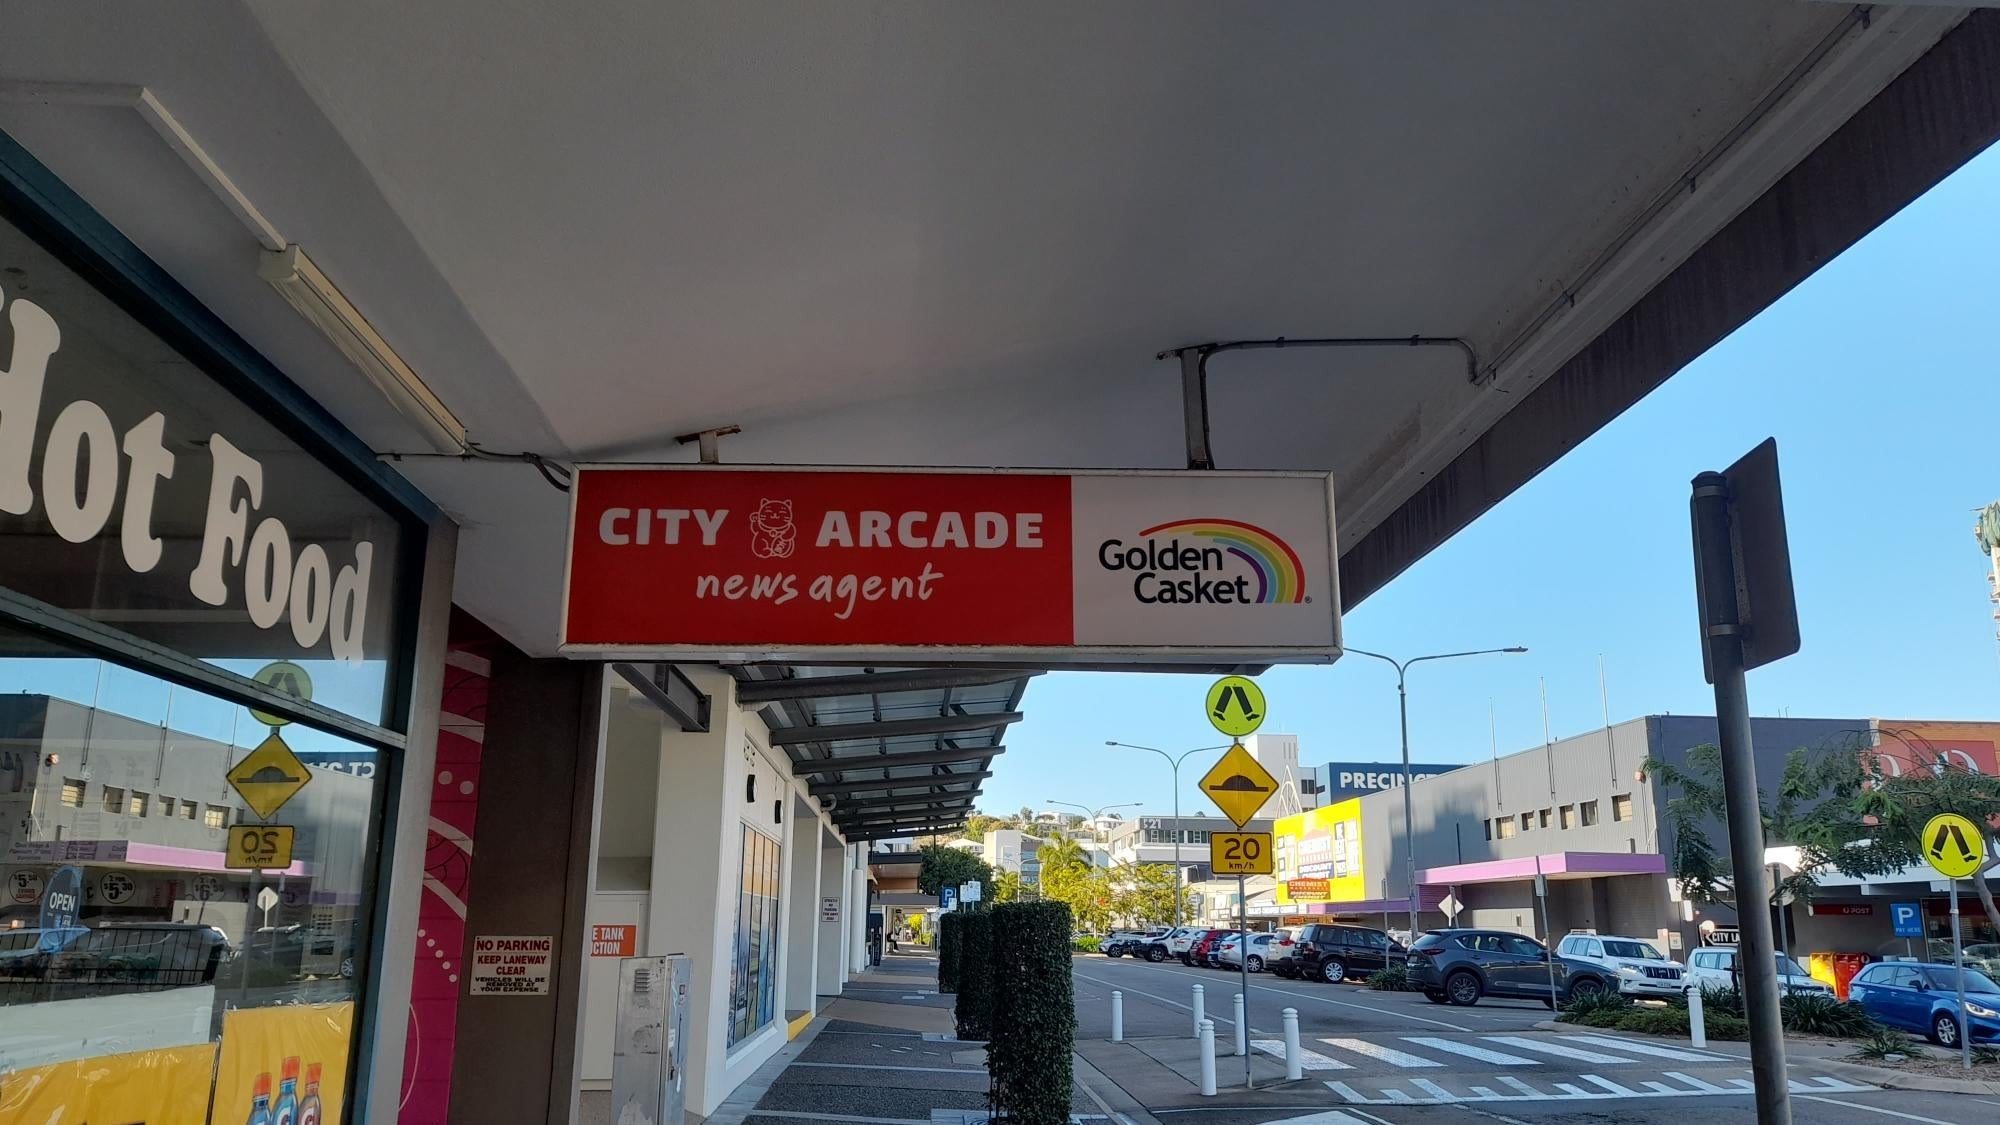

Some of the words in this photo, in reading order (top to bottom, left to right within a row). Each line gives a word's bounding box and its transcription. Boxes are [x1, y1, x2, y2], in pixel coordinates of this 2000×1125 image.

[0, 282, 175, 573] Hot
[189, 432, 373, 668] Food
[598, 508, 730, 545] CITY
[815, 511, 1043, 549] ARCADE
[1098, 539, 1223, 571] Golden
[696, 572, 799, 604] news
[808, 562, 944, 620] agent
[1133, 572, 1251, 604] Casket
[1340, 771, 1441, 789] PRECINC
[1224, 838, 1260, 860] 20
[1229, 862, 1255, 870] km/h
[49, 891, 76, 912] OPEN
[1897, 907, 1914, 925] P
[600, 927, 624, 940] TANK
[1711, 932, 1729, 943] CITY
[1730, 932, 1741, 943] LA
[476, 940, 494, 951] NO
[497, 940, 550, 951] PARKING
[592, 941, 620, 955] CTION
[478, 955, 502, 964] KEEP
[504, 955, 547, 964] LANEWAY
[496, 966, 526, 975] CLEAR
